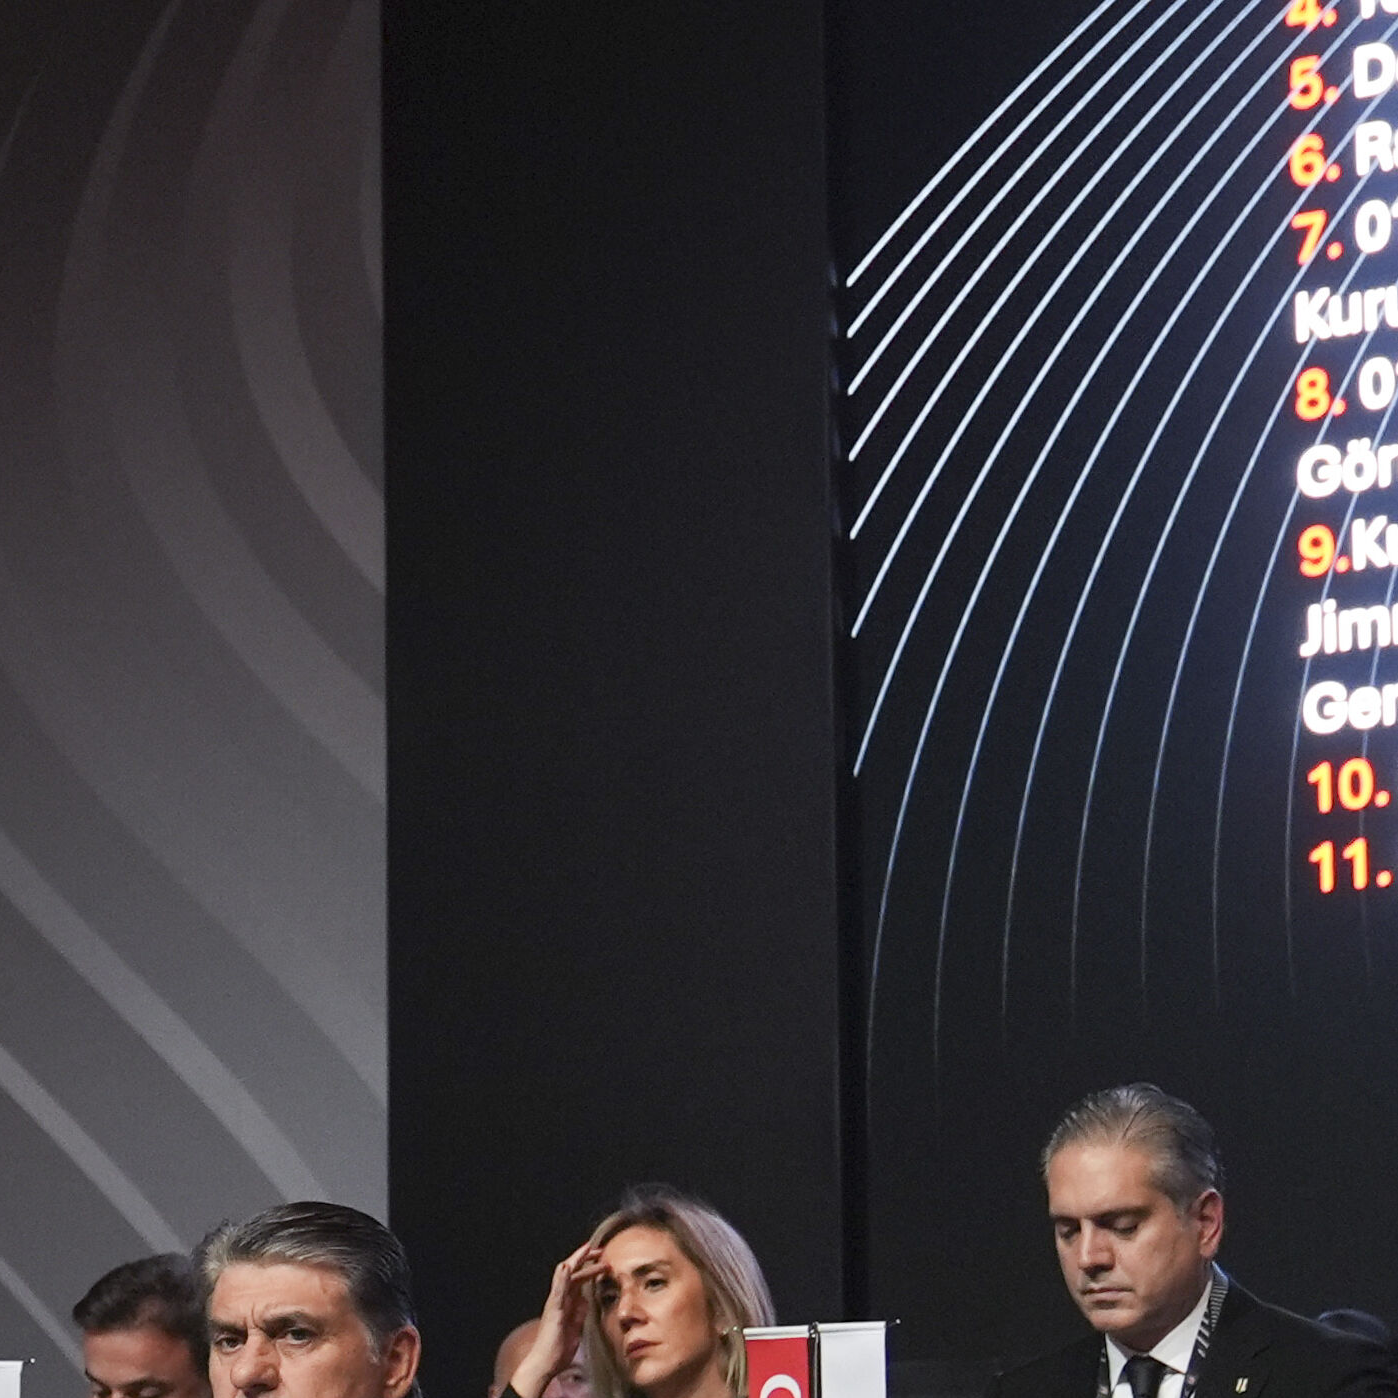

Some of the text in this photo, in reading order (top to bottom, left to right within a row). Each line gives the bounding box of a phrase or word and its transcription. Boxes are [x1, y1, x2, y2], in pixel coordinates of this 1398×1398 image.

[1288, 42, 1398, 110] 5. D
[1288, 120, 1398, 188] 6. R
[1290, 209, 1344, 266] 7.
[1295, 367, 1347, 421] 8.
[1299, 598, 1398, 658] Jim
[1307, 757, 1391, 814] 10.
[1309, 836, 1393, 894] 11.
